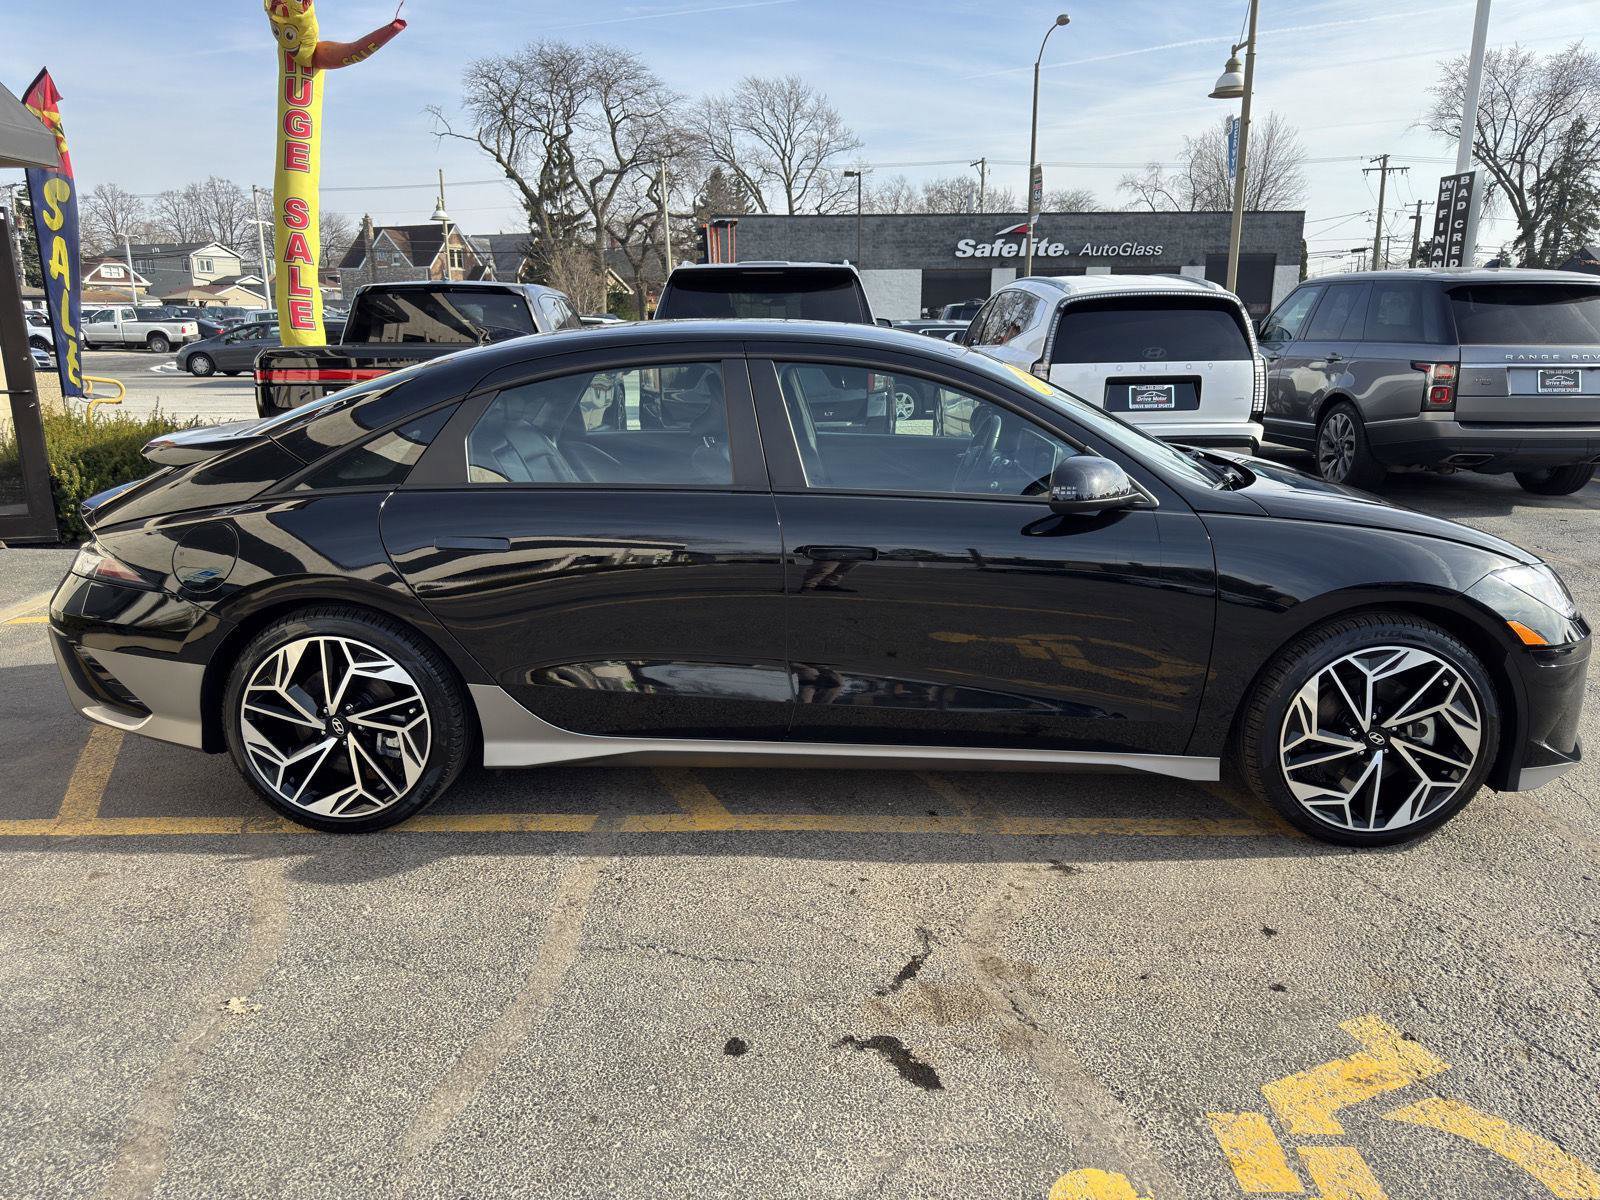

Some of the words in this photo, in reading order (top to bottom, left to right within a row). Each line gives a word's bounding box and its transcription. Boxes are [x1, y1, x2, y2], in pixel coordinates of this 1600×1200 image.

[1441, 180, 1454, 201] WE
[1456, 175, 1470, 211] BAD
[283, 197, 316, 331] SALE
[955, 237, 1065, 258] Safelite
[1079, 242, 1163, 257] AutoGlass
[42, 178, 81, 388] SALE
